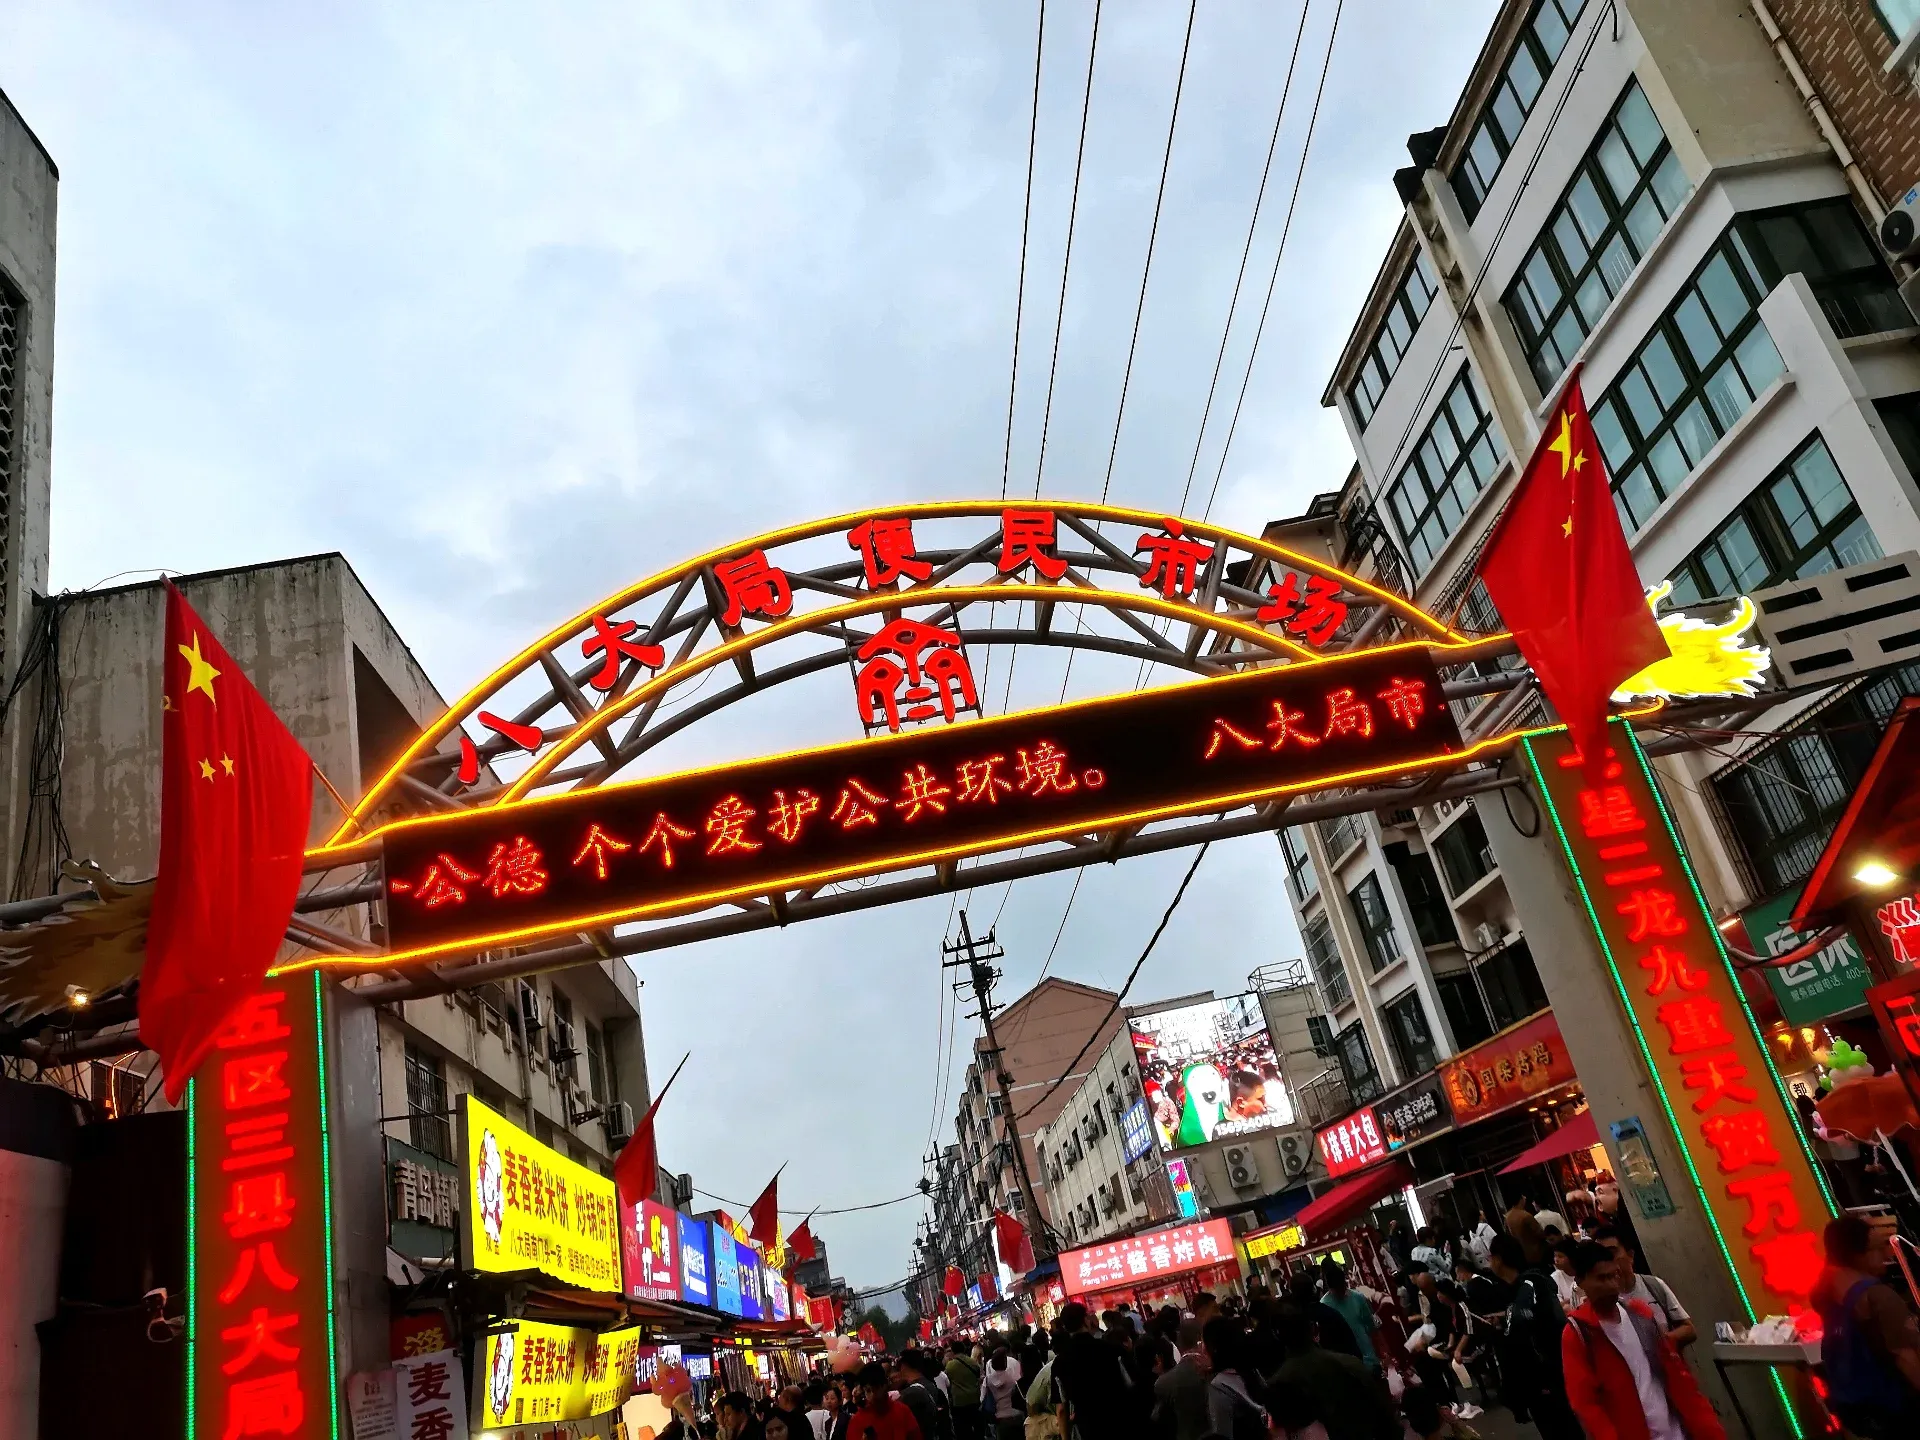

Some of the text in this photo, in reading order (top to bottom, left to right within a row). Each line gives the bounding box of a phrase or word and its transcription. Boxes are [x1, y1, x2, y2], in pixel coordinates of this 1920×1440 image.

[457, 509, 1349, 785] 八大局便民市场
[392, 677, 1453, 906] 公德 个个爱护公共环境。 八大局市
[1326, 1113, 1380, 1164] 排骨大包
[215, 991, 304, 1440] 五区三县八大局
[504, 1146, 570, 1231] 麦香紫米饼
[573, 1183, 608, 1245] 炒锅饼
[1126, 1234, 1220, 1276] 酱香炸肉
[407, 1361, 455, 1440] 麦香
[521, 1334, 577, 1386] 麦香紫米饼
